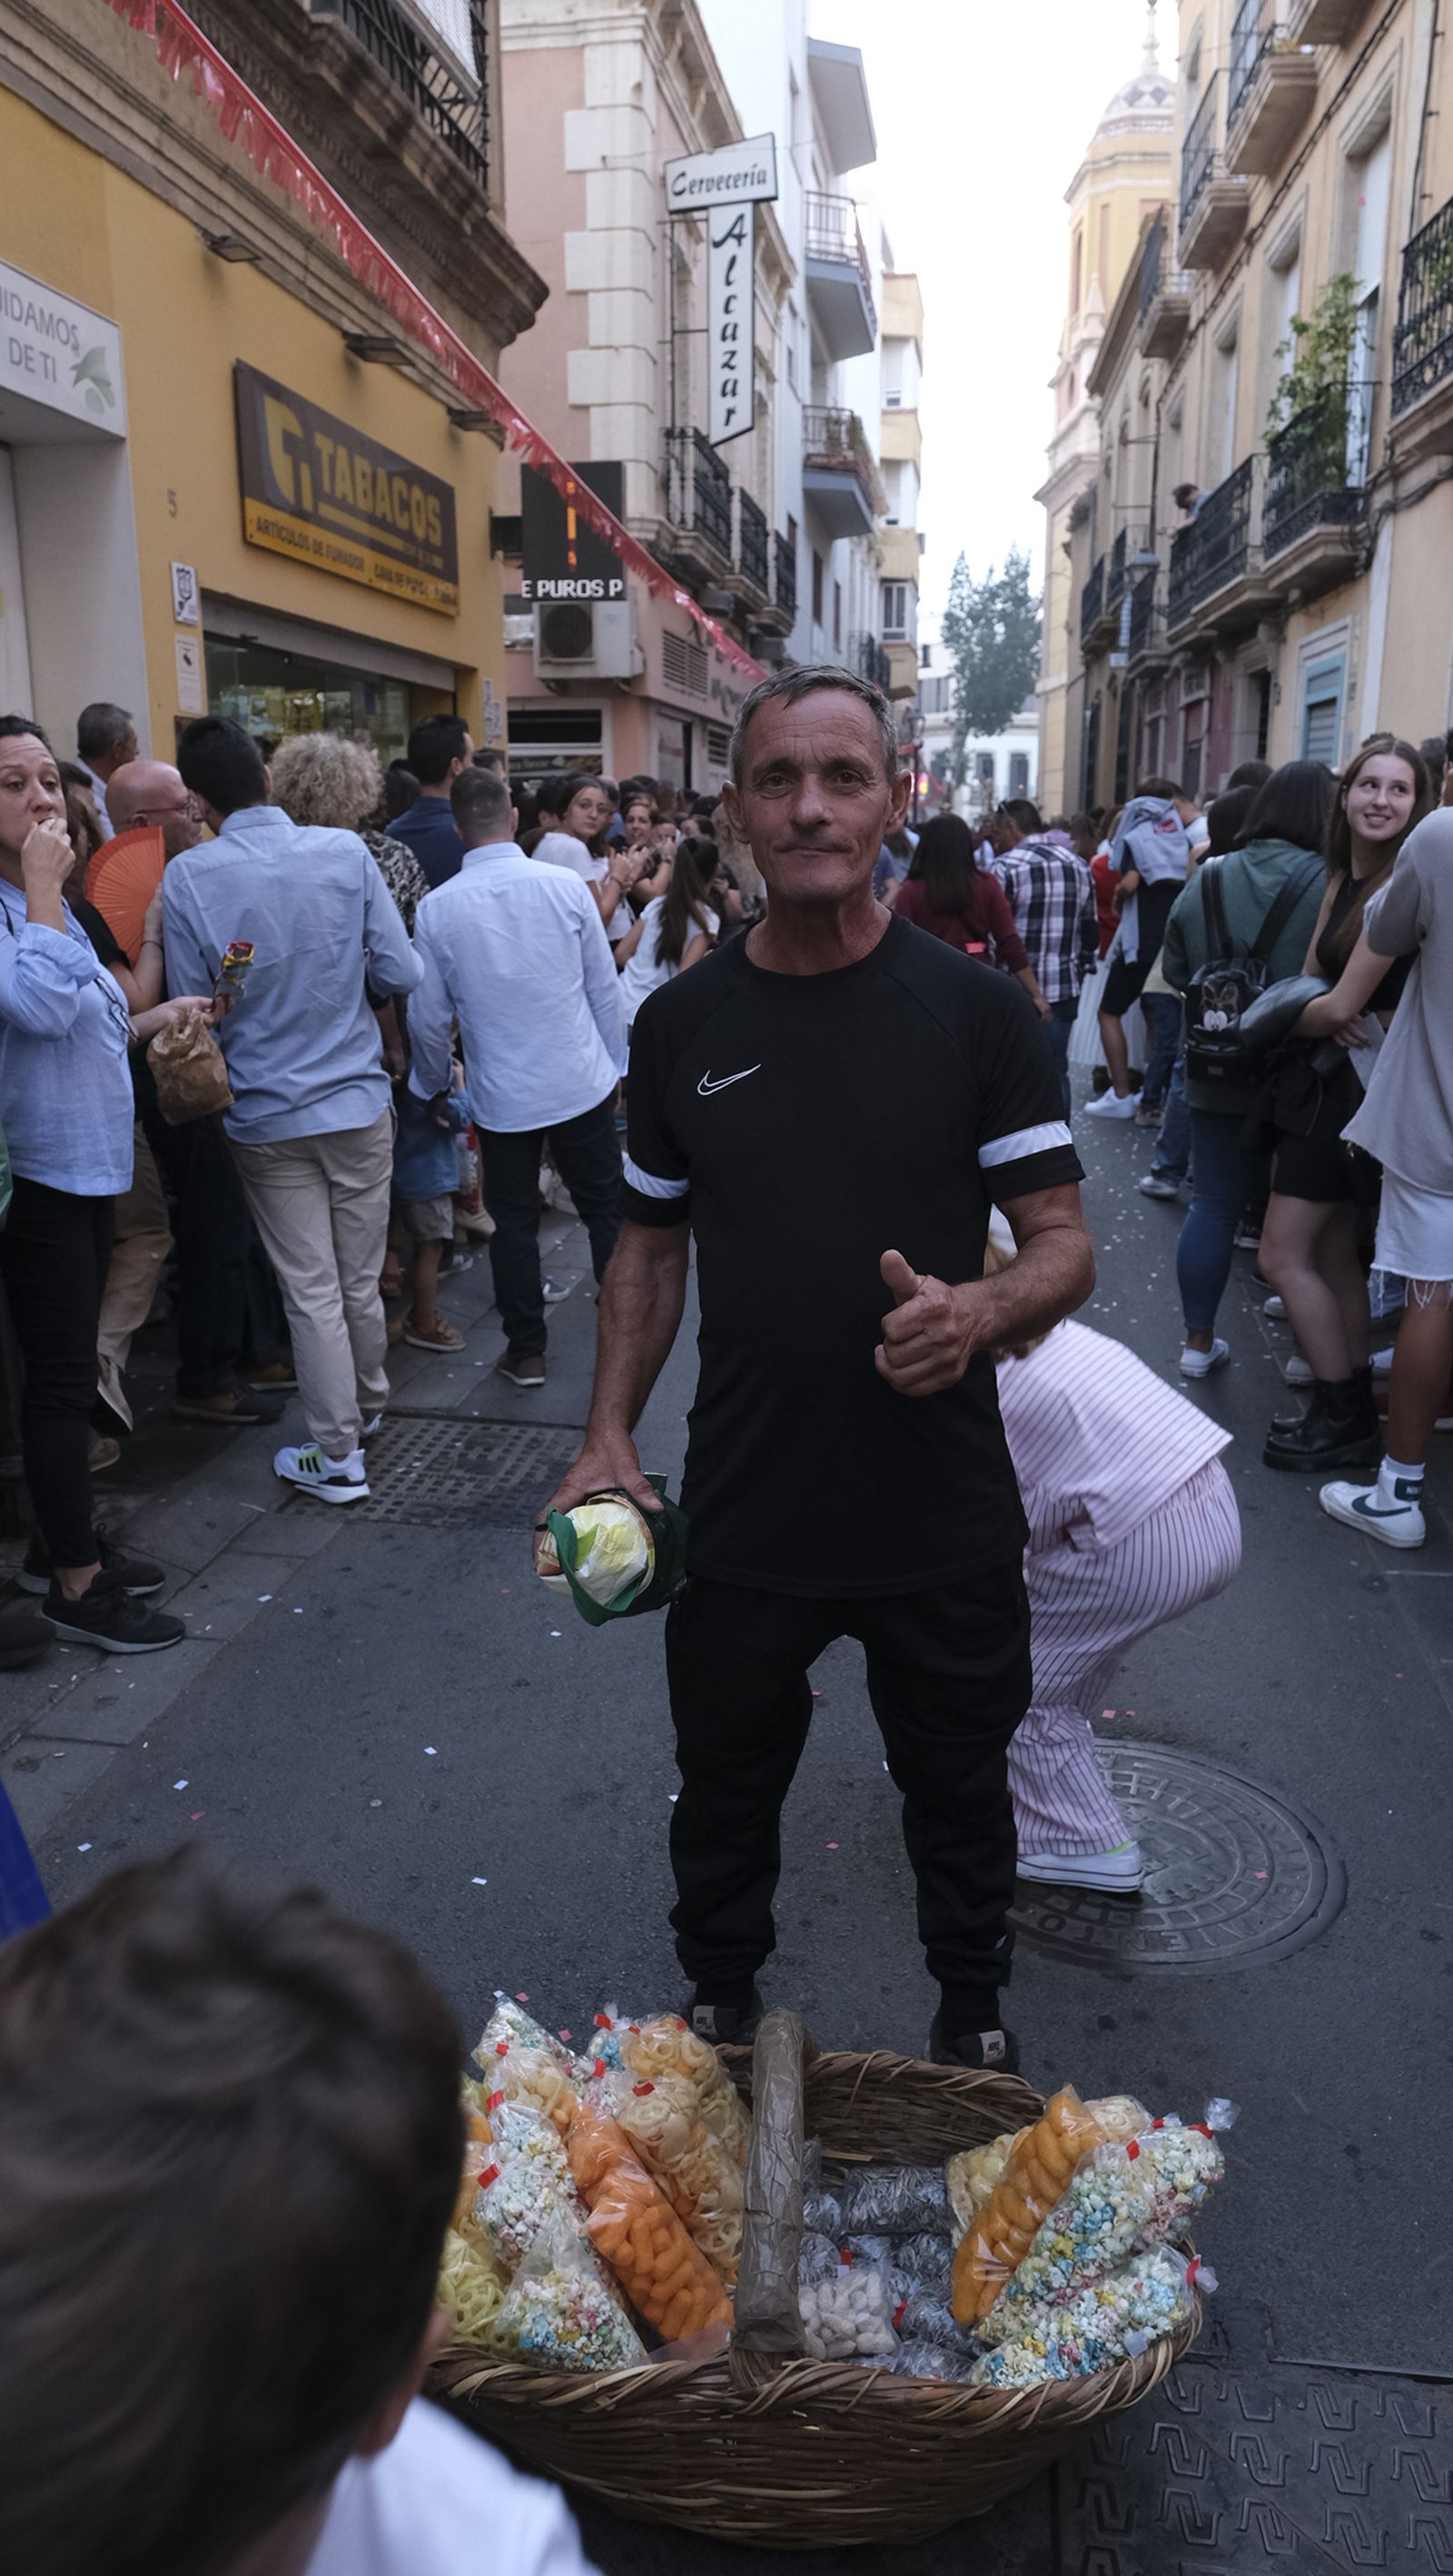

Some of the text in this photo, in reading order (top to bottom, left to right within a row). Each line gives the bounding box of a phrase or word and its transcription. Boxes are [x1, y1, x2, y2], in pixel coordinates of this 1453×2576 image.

[671, 163, 767, 197] Cervecería
[712, 213, 746, 427] Alcazar
[8, 337, 57, 383] DE TI
[167, 488, 178, 518] 5
[314, 430, 442, 547] TABACOS
[537, 579, 605, 598] PUROS
[609, 579, 623, 597] P
